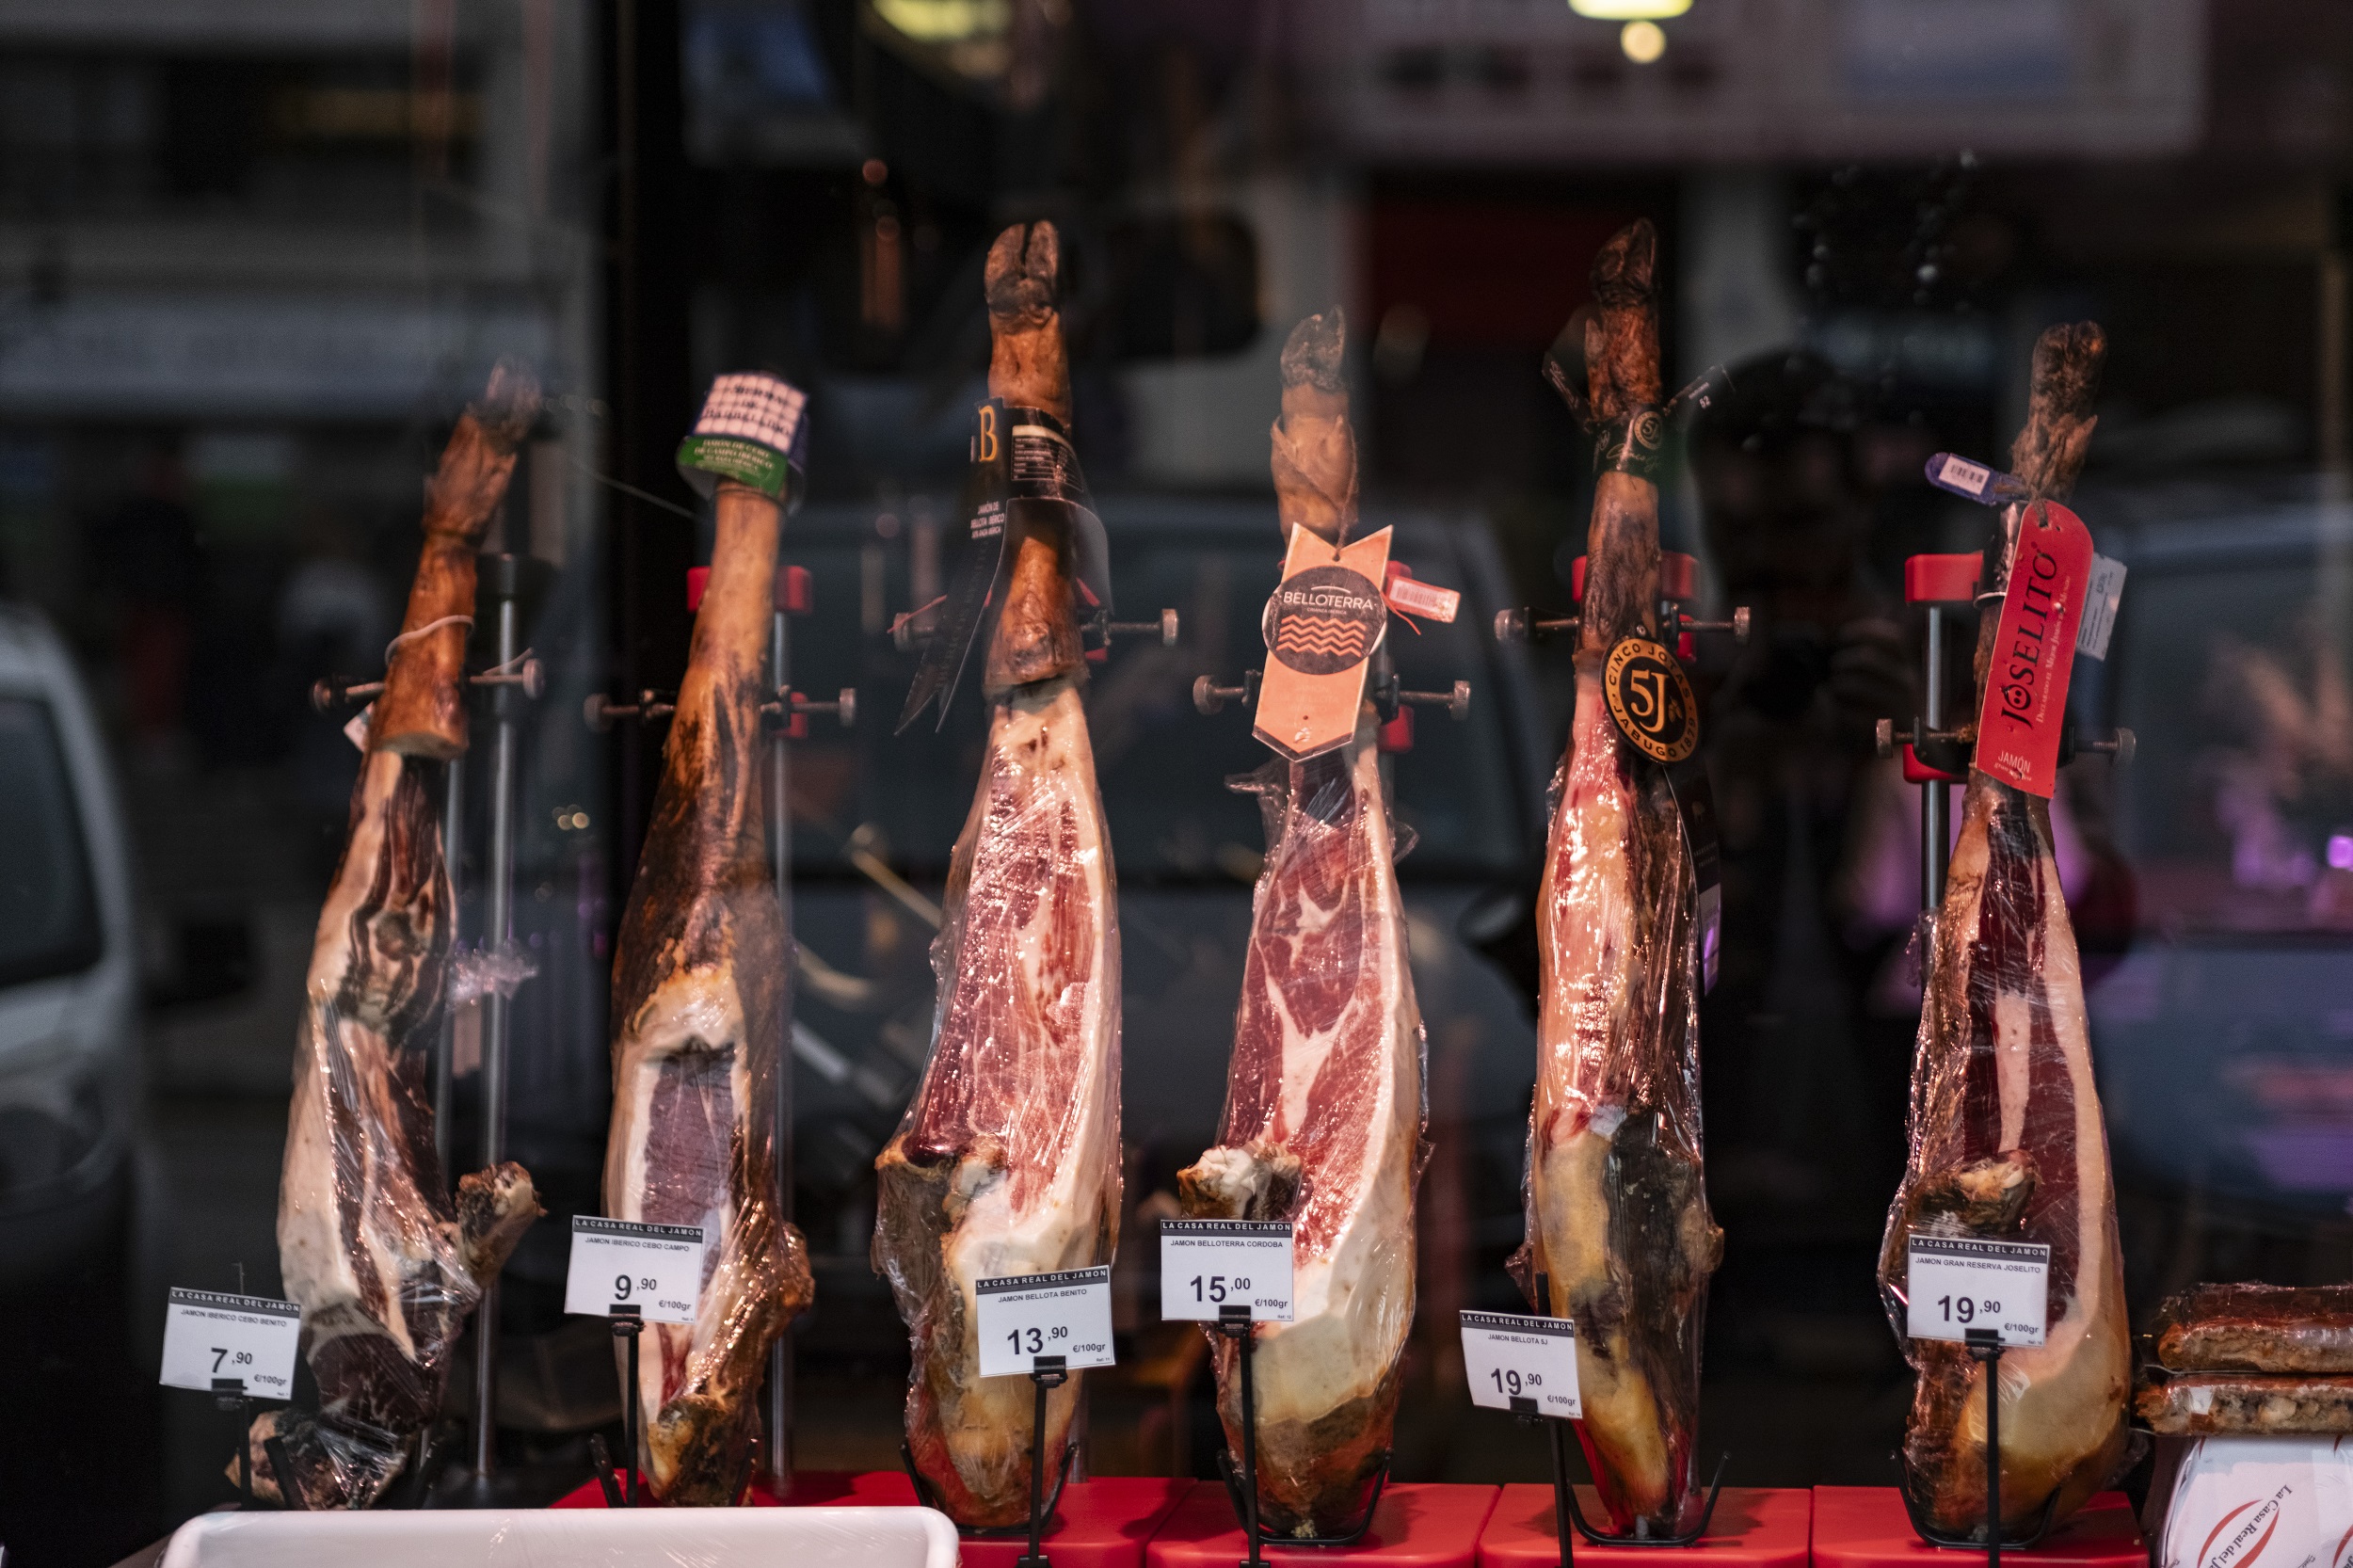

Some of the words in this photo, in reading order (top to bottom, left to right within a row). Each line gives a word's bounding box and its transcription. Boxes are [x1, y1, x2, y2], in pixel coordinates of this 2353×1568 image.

[979, 405, 998, 462] B
[1284, 591, 1373, 610] BELLOTERRA
[2000, 552, 2057, 730] JOSELITO
[1609, 643, 1641, 685] CINCO
[1648, 646, 1690, 698] JOTAS
[1630, 668, 1670, 732] 5J
[1613, 705, 1677, 758] JABUGO
[1679, 717, 1696, 753] 1879
[1997, 750, 2030, 774] JAMÓN
[618, 1223, 644, 1231] REAL
[664, 1243, 689, 1252] CAMPO
[1928, 1240, 1954, 1249] CASA
[2010, 1247, 2046, 1256] JAMON
[1915, 1256, 1942, 1265] JAMON
[1966, 1262, 2001, 1271] RESERVA
[2004, 1265, 2041, 1273] JOSELITO
[977, 1280, 989, 1288] LA
[992, 1278, 1019, 1287] CASA
[1072, 1270, 1106, 1279] JAMON
[186, 1292, 213, 1302] CASA
[216, 1296, 241, 1305] REAL
[244, 1299, 262, 1307] DEL
[265, 1302, 299, 1312] JAMON
[1026, 1292, 1058, 1301] BELLOTA
[1255, 1299, 1288, 1308] €/100gr
[659, 1300, 691, 1311] €/100gr
[207, 1312, 236, 1320] IBERICO
[260, 1319, 286, 1327] BENITO
[1499, 1318, 1521, 1326] REAL
[2005, 1323, 2039, 1334] €/100gr
[1073, 1343, 1105, 1352] €/100gr
[254, 1374, 287, 1385] €/100gr
[1547, 1395, 1576, 1406] €/100gr
[2276, 1484, 2293, 1500] La
[2253, 1499, 2280, 1524] Casa
[2233, 1523, 2258, 1549] Real
[2217, 1545, 2235, 1566] del
